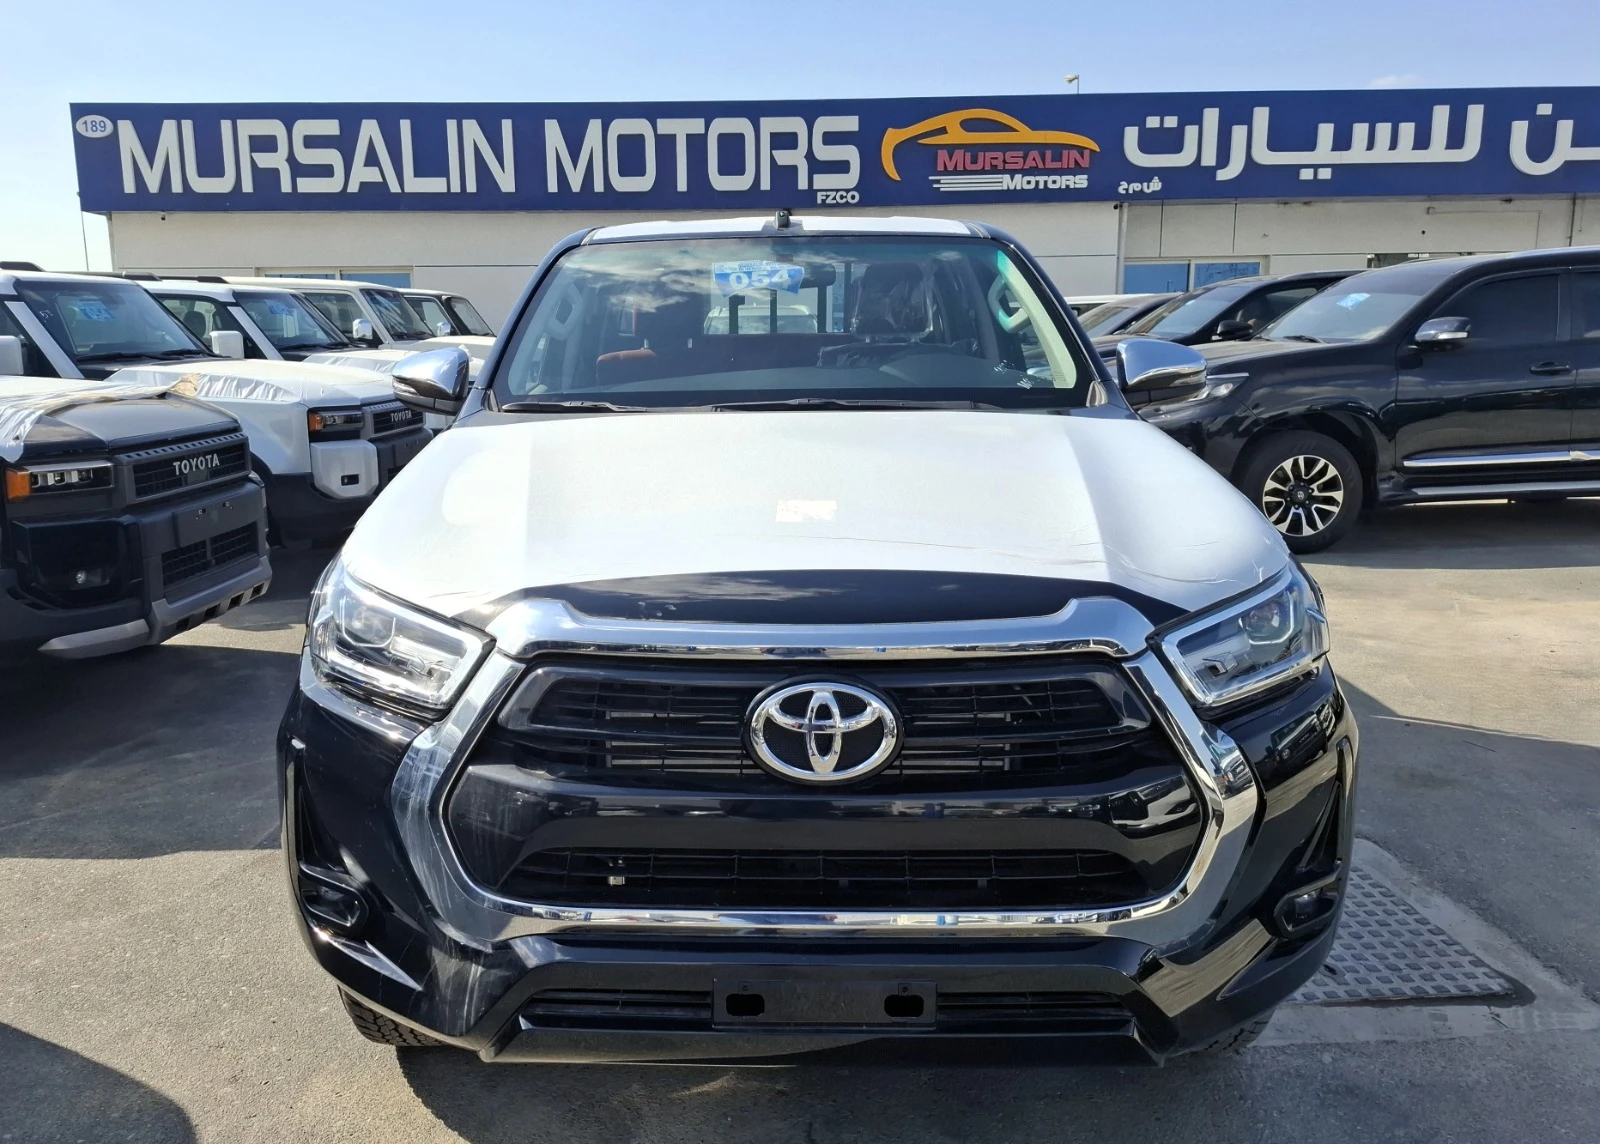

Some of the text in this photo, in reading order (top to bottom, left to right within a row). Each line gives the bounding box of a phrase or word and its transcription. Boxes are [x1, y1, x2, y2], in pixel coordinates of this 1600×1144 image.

[82, 119, 107, 133] 189
[1123, 103, 1485, 181] للسيارات
[117, 115, 861, 194] MURSALIN MOTORS
[937, 149, 1091, 171] MURSALIN
[1002, 173, 1089, 190] MOTORS
[816, 190, 860, 204] FZCO
[729, 269, 791, 290] 054
[390, 410, 413, 422] TOYOTA
[172, 453, 220, 476] TOYOTA
